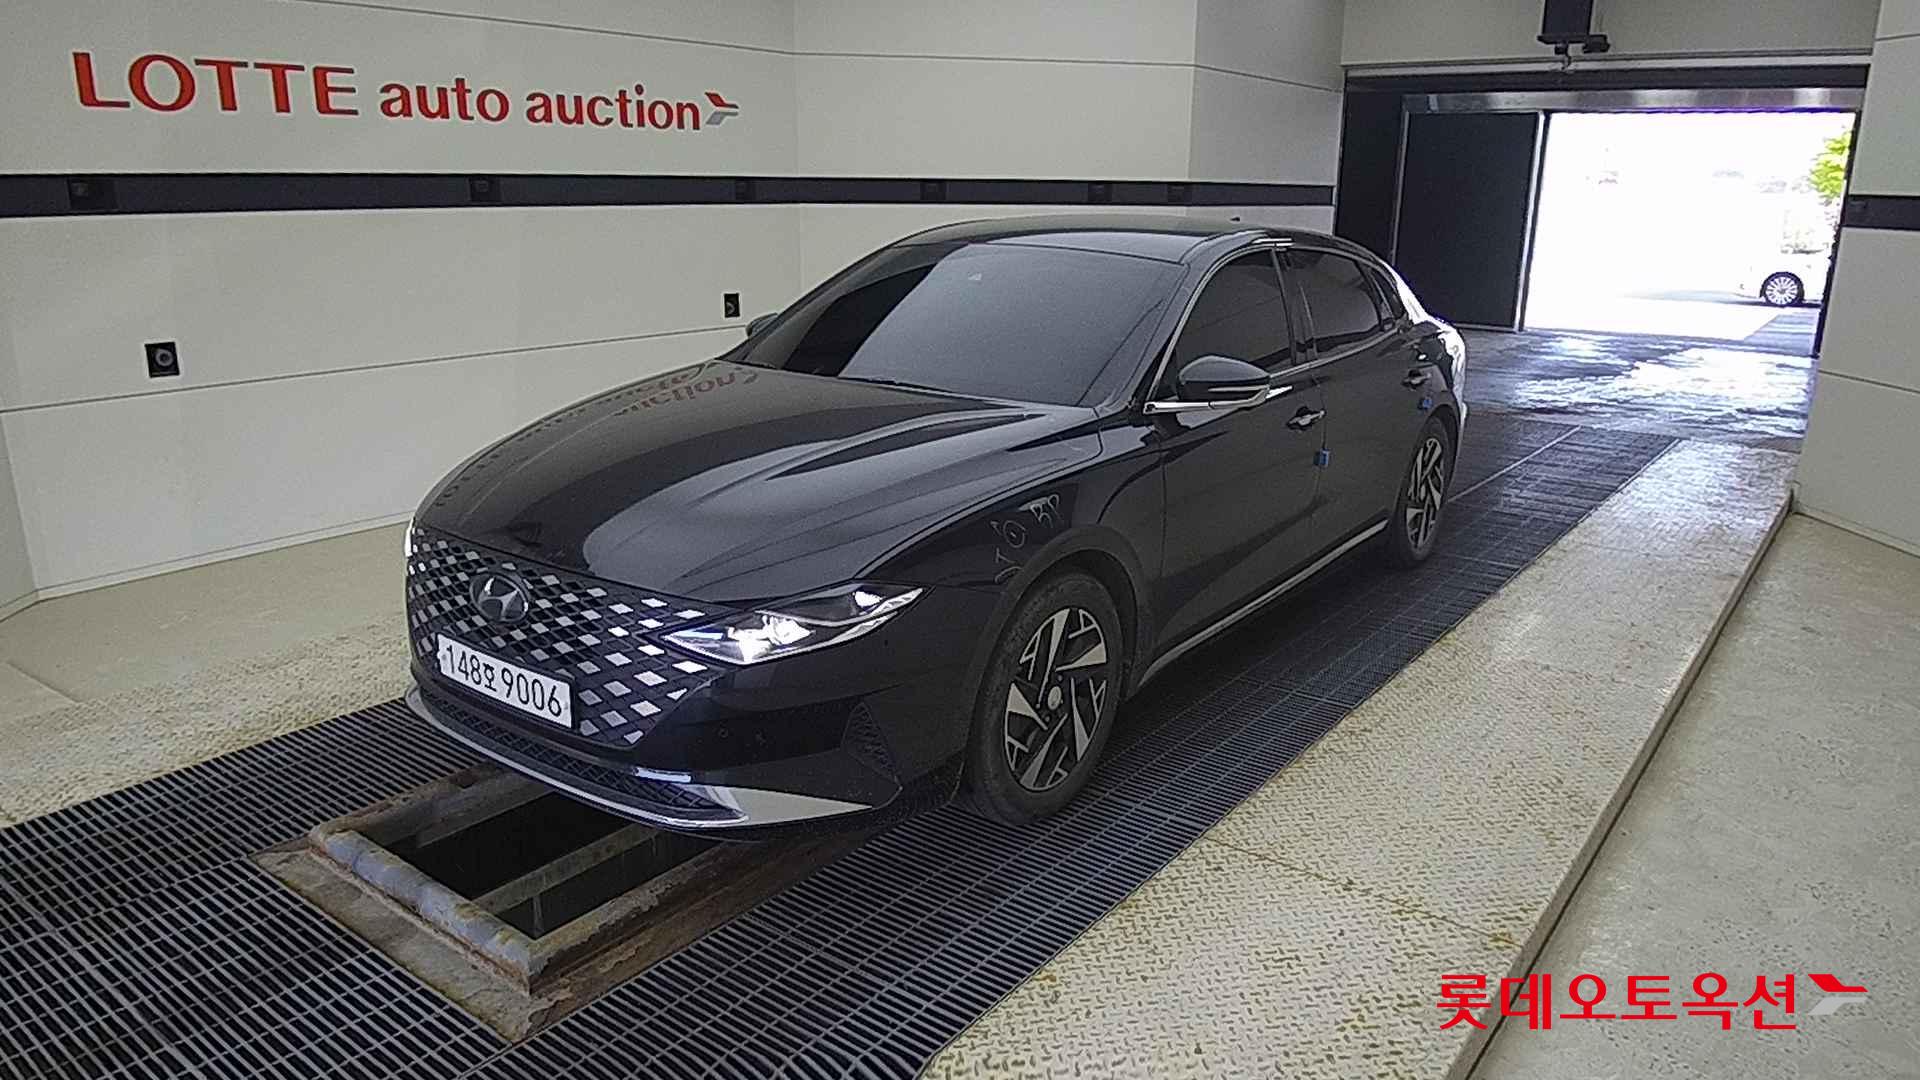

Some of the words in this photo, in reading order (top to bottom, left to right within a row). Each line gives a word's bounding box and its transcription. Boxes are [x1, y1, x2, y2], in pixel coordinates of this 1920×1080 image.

[72, 51, 360, 117] LOTTE
[380, 77, 509, 123] auto
[526, 84, 701, 130] auction
